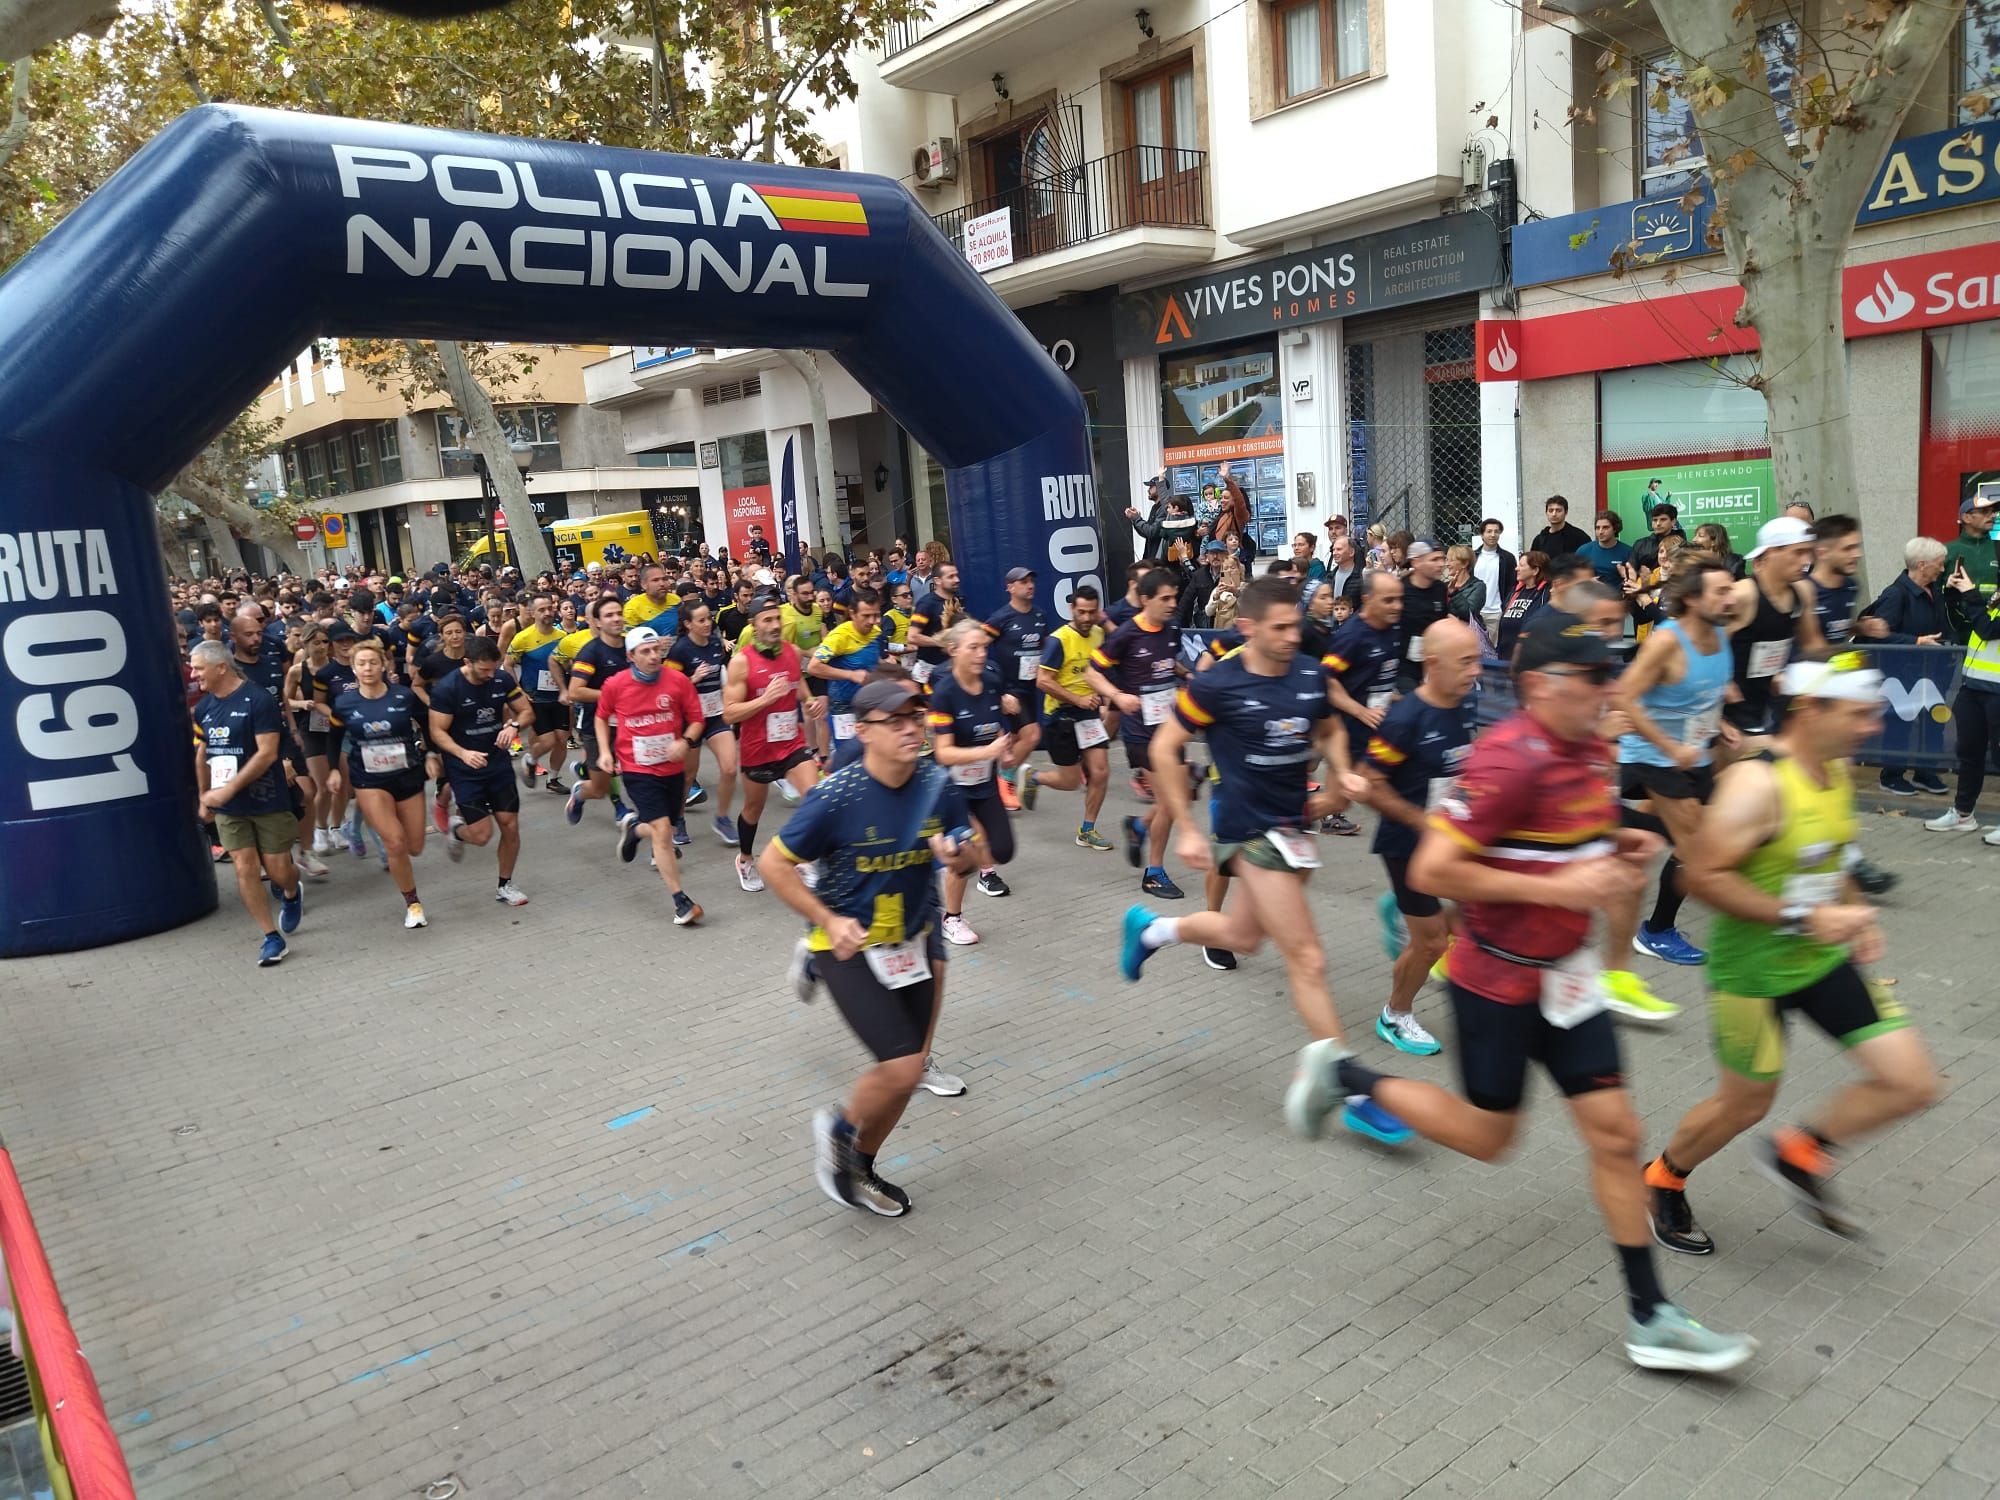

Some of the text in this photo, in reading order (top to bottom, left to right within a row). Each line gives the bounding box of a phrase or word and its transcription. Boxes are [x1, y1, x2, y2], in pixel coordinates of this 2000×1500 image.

[1868, 136, 2000, 210] AS
[969, 230, 1007, 251] SE ALQUILA
[983, 248, 995, 263] 890
[996, 244, 1009, 259] 086
[1383, 234, 1450, 261] REAL ESTATE
[346, 213, 871, 298] NACIONAL
[1383, 251, 1465, 280] CONSTRUCTION
[1184, 253, 1356, 320] VIVES PONS
[1384, 271, 1462, 297] ARCHITECTURE
[1925, 272, 2000, 314] Sa
[1273, 290, 1356, 321] HOMES
[1292, 380, 1310, 392] VP
[1165, 450, 1187, 461] ESTUDIO
[1188, 450, 1195, 459] DE
[1196, 447, 1236, 459] ARQUITECTURA
[1677, 466, 1753, 480] BIENESTANDO
[738, 497, 757, 507] LOCAL
[1041, 475, 1095, 520] RUTA
[1696, 494, 1753, 510] SMUSIC
[733, 506, 766, 518] DISPONIBLE
[0, 529, 119, 603] RUTA
[3, 609, 150, 811] 091
